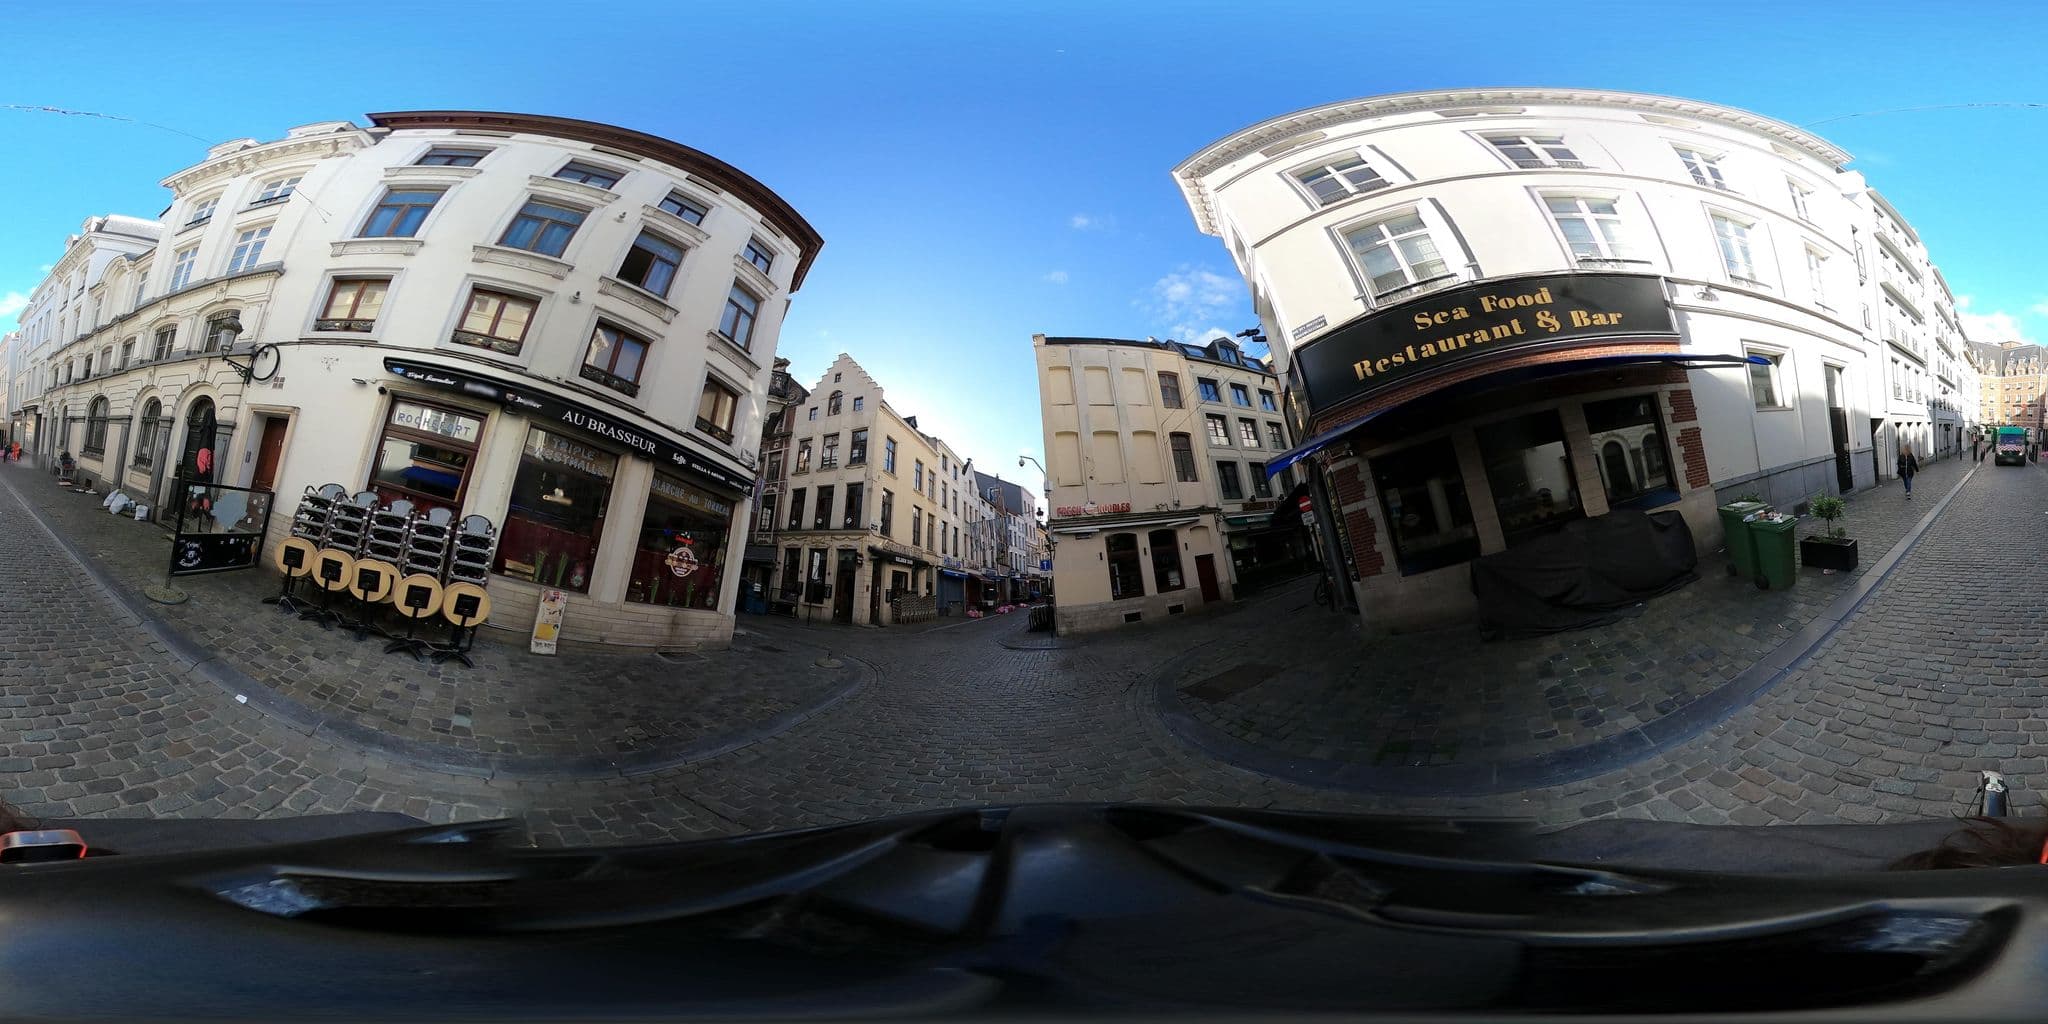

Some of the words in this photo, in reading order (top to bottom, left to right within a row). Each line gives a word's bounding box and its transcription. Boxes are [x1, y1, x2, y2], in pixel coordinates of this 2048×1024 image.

[1413, 306, 1470, 331] Sea
[1480, 287, 1554, 314] Food
[1352, 318, 1527, 382] Restaurant
[1535, 310, 1561, 333] &
[1569, 310, 1624, 328] Bar
[397, 412, 471, 436] ROCHEFORT
[562, 410, 585, 426] AU
[587, 418, 656, 455] BRASSEUR
[552, 437, 596, 460] TRIPLE
[1097, 502, 1131, 514] NOODLES
